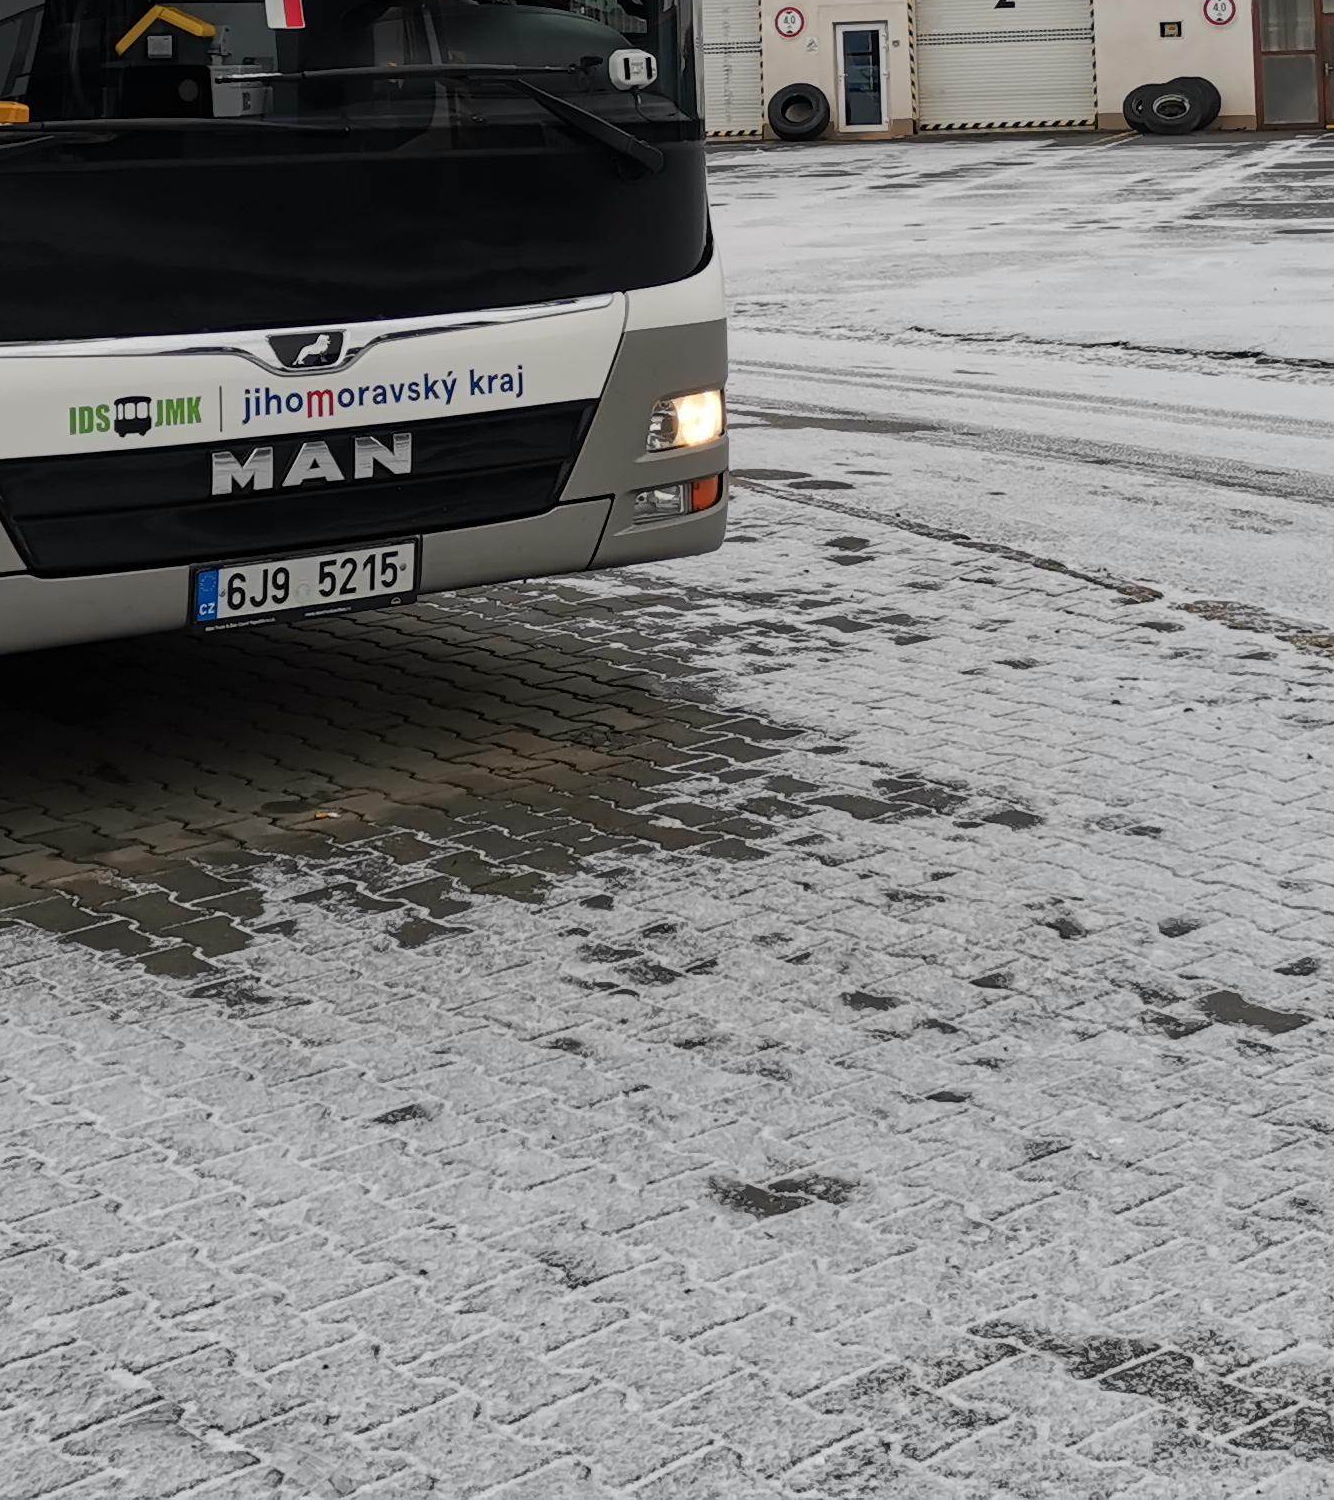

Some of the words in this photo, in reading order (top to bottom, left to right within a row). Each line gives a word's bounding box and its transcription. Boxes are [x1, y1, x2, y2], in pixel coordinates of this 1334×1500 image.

[69, 404, 111, 436] IDS
[155, 396, 202, 428] JMK
[242, 371, 457, 425] jihomoravský
[469, 364, 524, 398] kraj
[212, 432, 412, 496] MAN
[199, 602, 216, 616] CZ
[227, 566, 290, 610] 6J9
[319, 550, 399, 597] 5215
